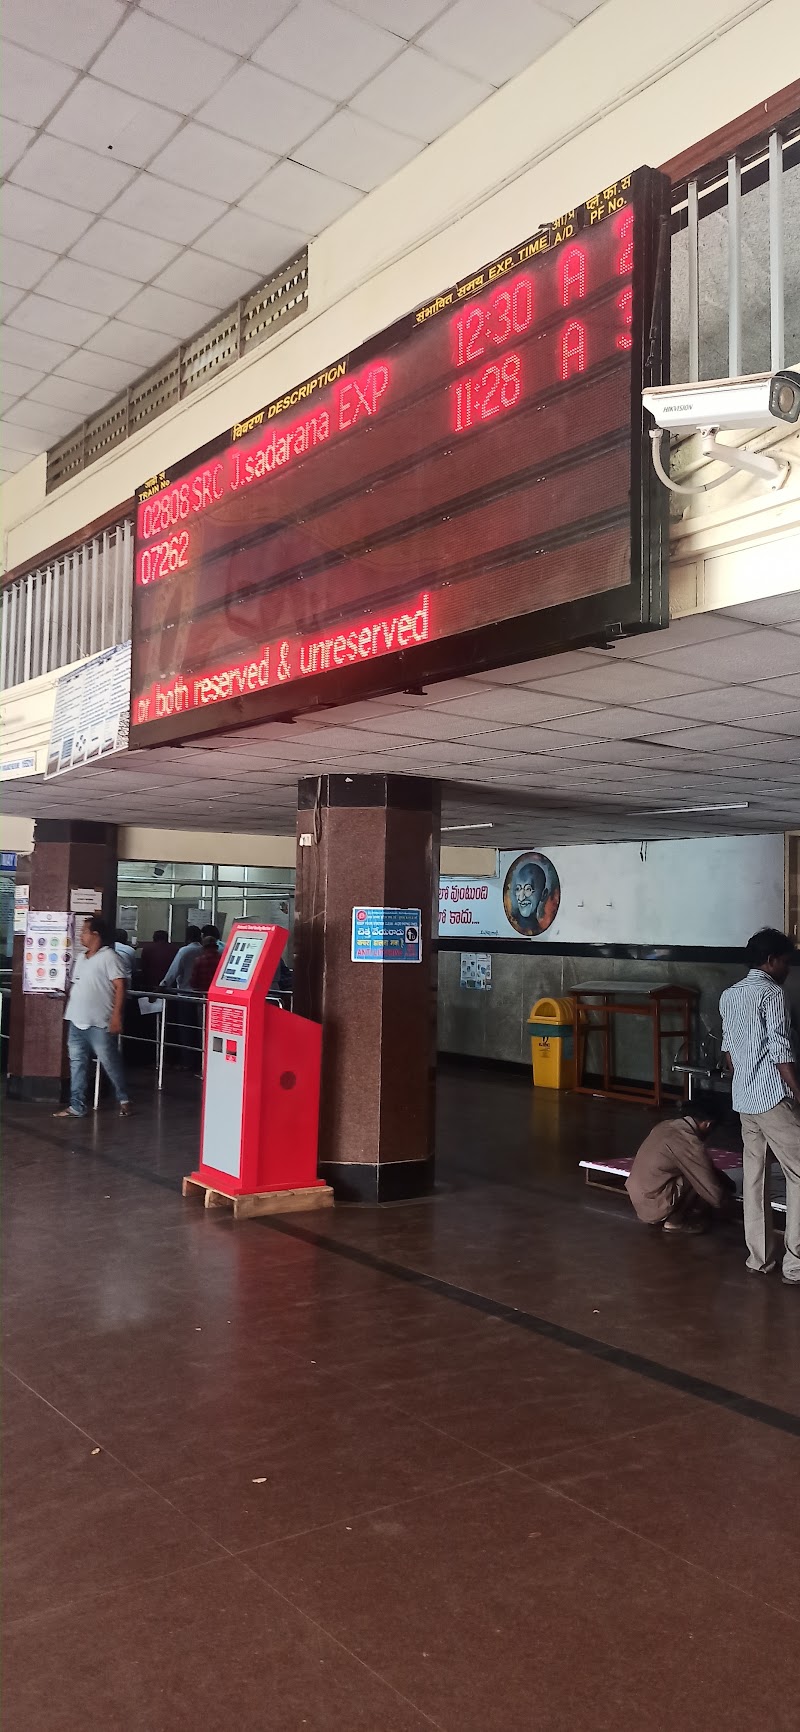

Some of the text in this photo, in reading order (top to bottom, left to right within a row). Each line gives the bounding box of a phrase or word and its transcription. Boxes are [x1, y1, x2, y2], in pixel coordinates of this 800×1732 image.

[554, 225, 574, 245] A/D
[590, 205, 605, 225] PF
[457, 274, 485, 298] समय
[488, 257, 514, 280] EXP.
[517, 236, 548, 260] TIME
[143, 483, 190, 539] 02808
[191, 464, 224, 511] SRC
[339, 366, 390, 431] EXP
[456, 278, 532, 367] 12:30
[563, 248, 585, 307] A
[232, 361, 347, 441] विवरण DESCRIPTION
[663, 404, 694, 413] HIKVISION
[141, 531, 189, 585] 07262
[454, 354, 521, 432] 11:28
[562, 321, 585, 380] A
[138, 484, 160, 502] TRAIN
[155, 675, 189, 718] both
[193, 647, 270, 706] reserved
[277, 641, 290, 681] &
[300, 594, 430, 674] unreserved
